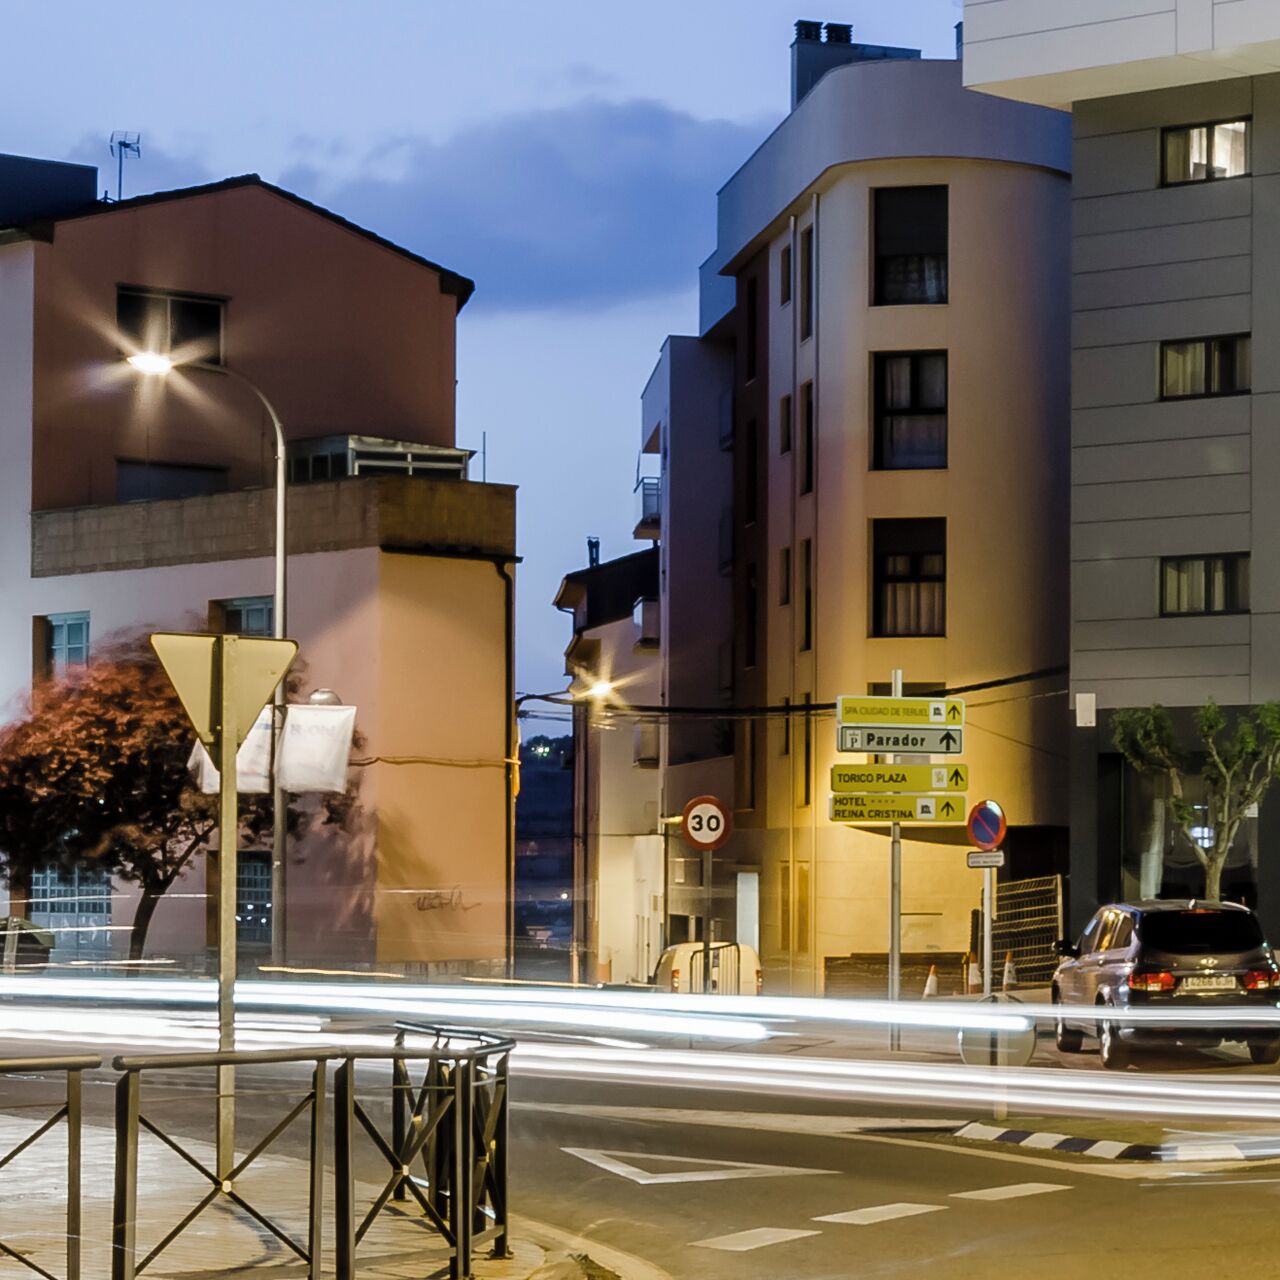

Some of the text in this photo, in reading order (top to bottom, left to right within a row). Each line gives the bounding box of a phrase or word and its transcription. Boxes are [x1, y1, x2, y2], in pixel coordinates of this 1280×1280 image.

[866, 733, 927, 747] Parador
[838, 773, 907, 783] TORICO PLAZA
[834, 797, 867, 807] HOTEL
[834, 809, 914, 819] REINA CRISTINA
[691, 814, 721, 832] 30
